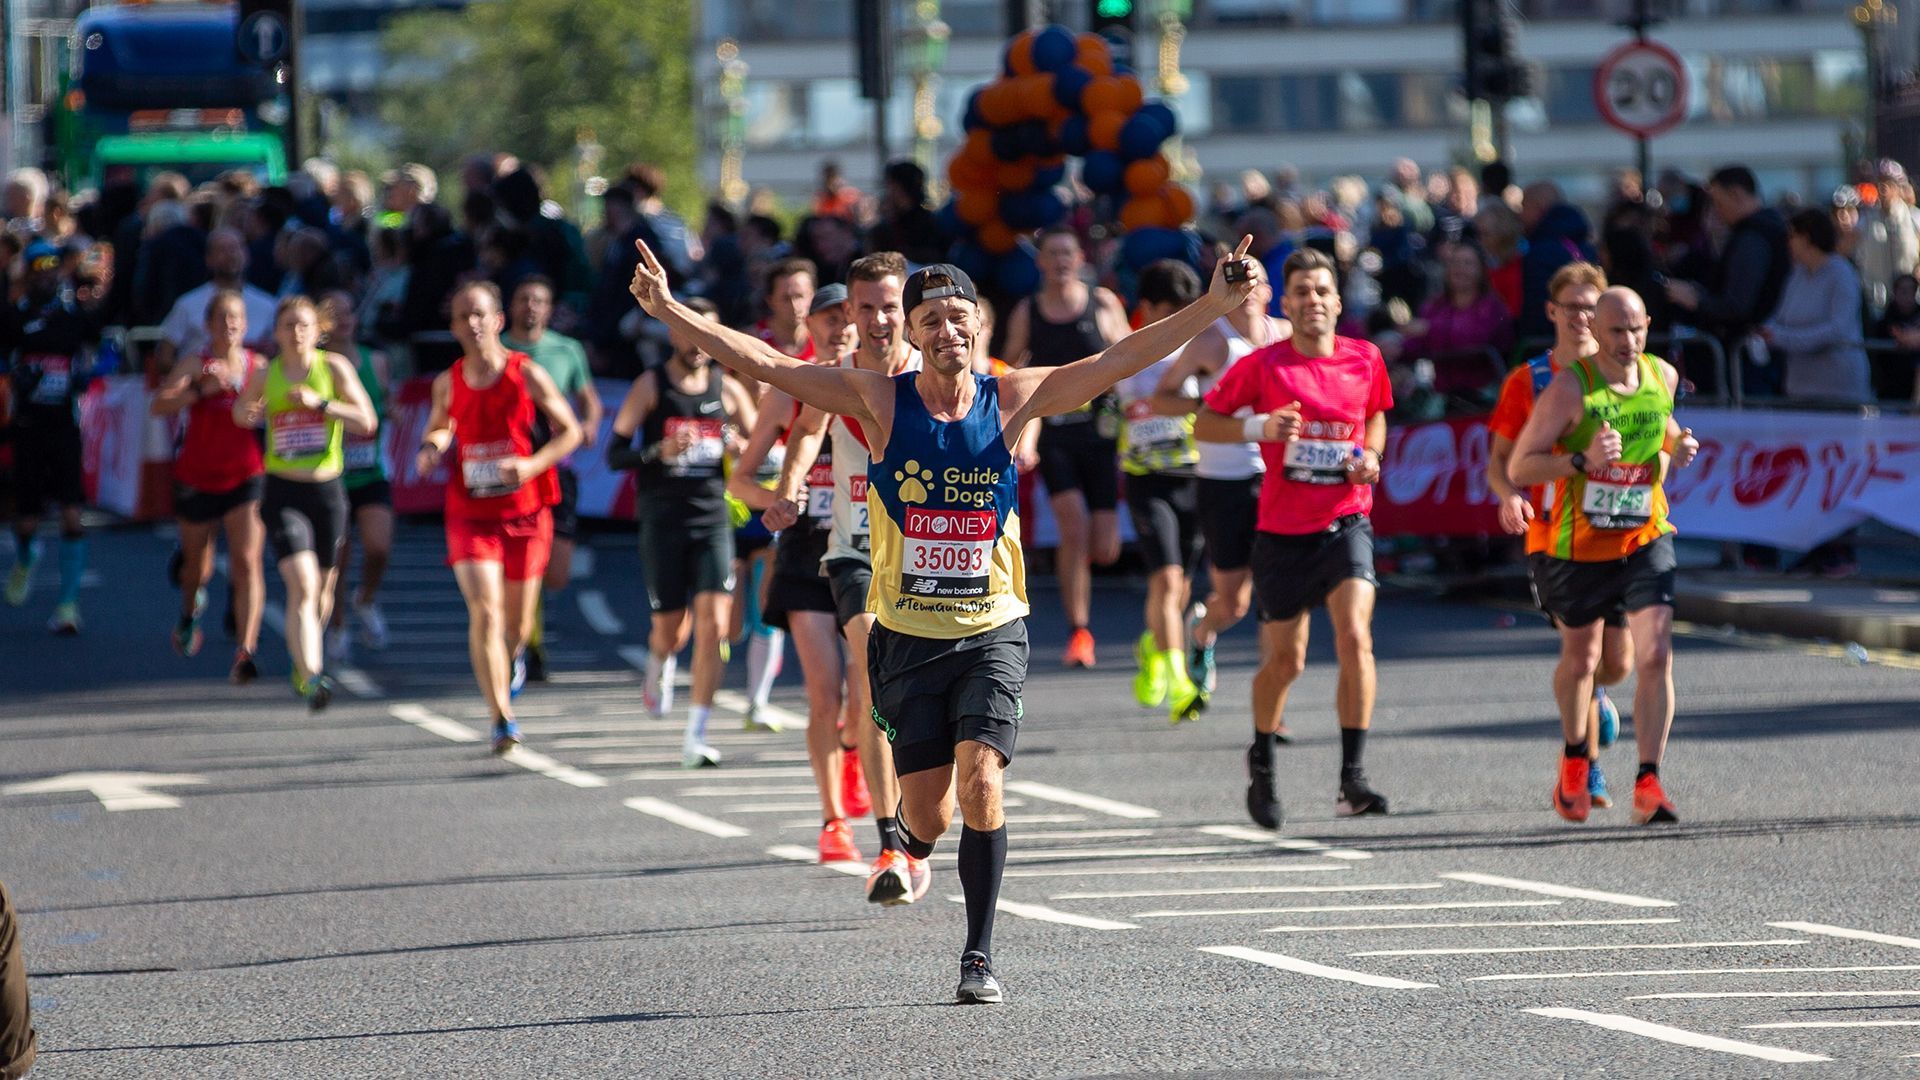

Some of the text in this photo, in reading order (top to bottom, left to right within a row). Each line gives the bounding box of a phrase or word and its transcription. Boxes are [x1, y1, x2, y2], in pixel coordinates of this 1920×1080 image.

[1613, 66, 1677, 111] 20
[943, 467, 1000, 484] Guide
[944, 488, 994, 507] Dogs
[909, 514, 992, 535] MONEY
[914, 545, 983, 571] 35093
[954, 586, 983, 595] balance
